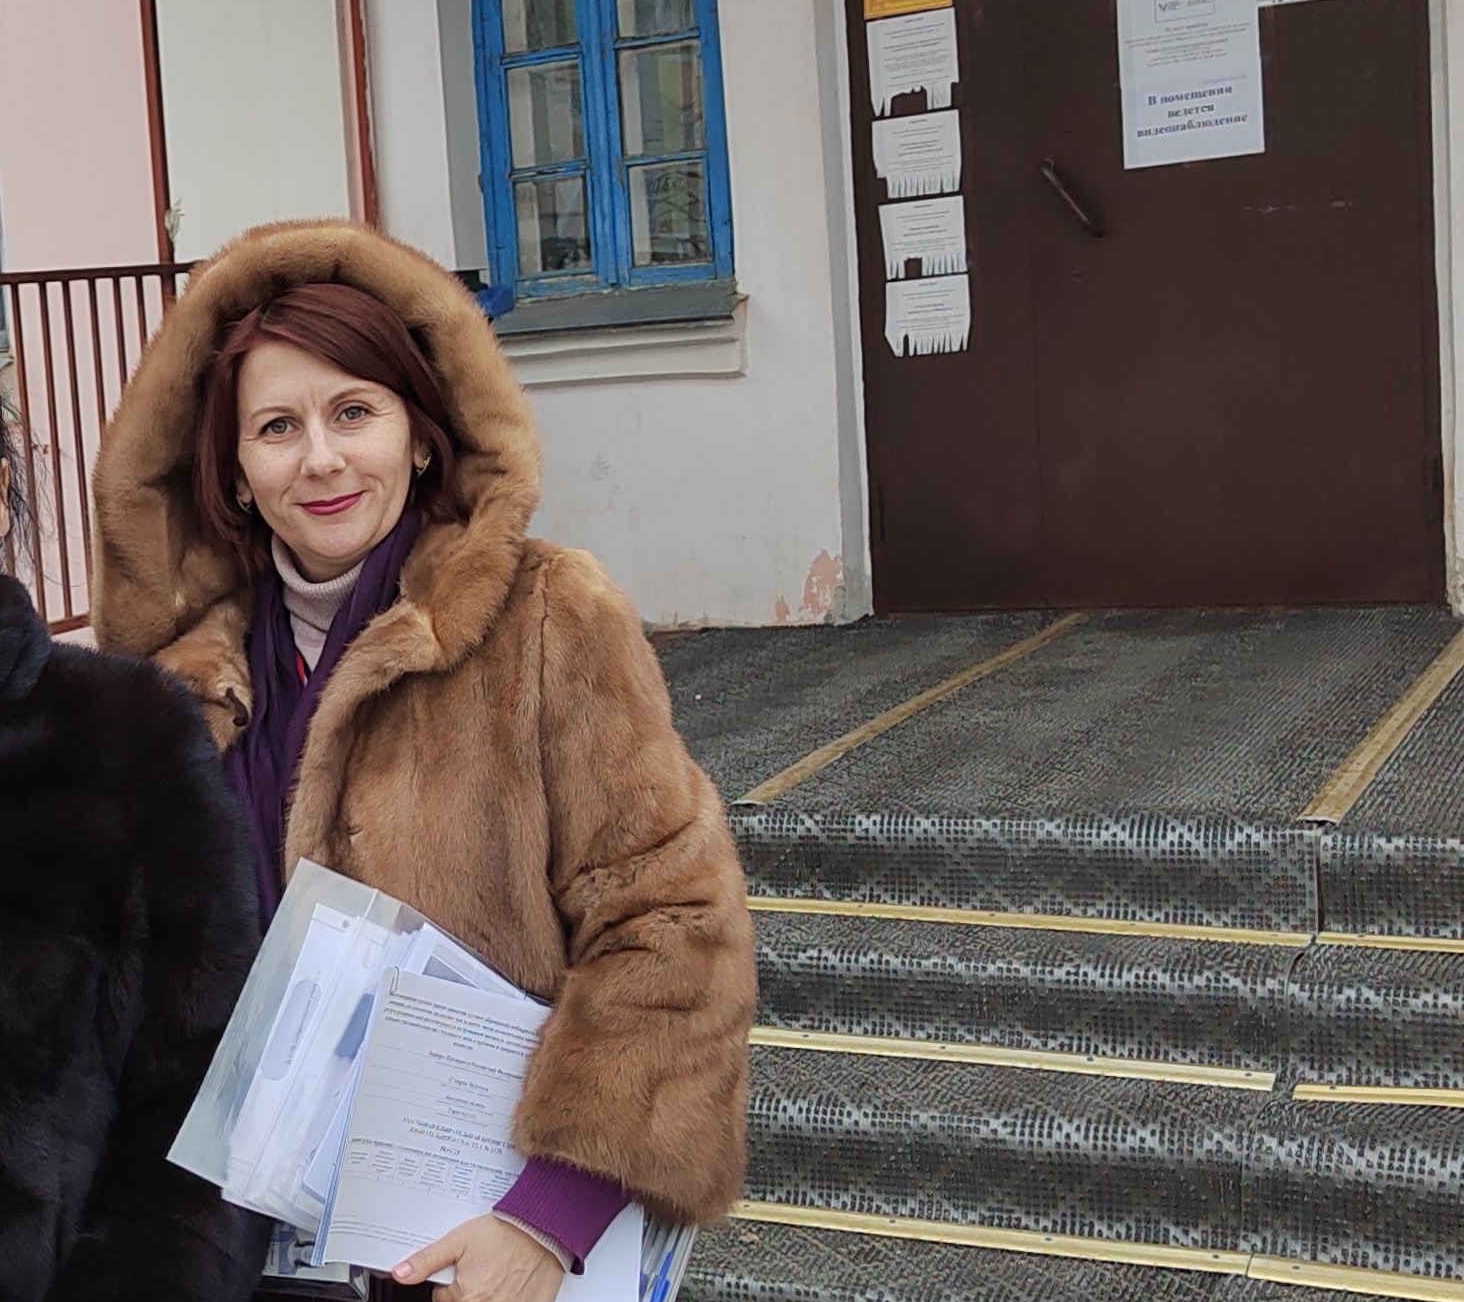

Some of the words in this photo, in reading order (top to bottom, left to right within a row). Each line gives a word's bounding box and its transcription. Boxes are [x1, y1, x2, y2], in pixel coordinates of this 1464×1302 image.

[1147, 95, 1157, 106] В
[1160, 86, 1233, 104] помещении
[1167, 103, 1215, 118] ведется
[1137, 113, 1249, 137] видеонаблюдение
